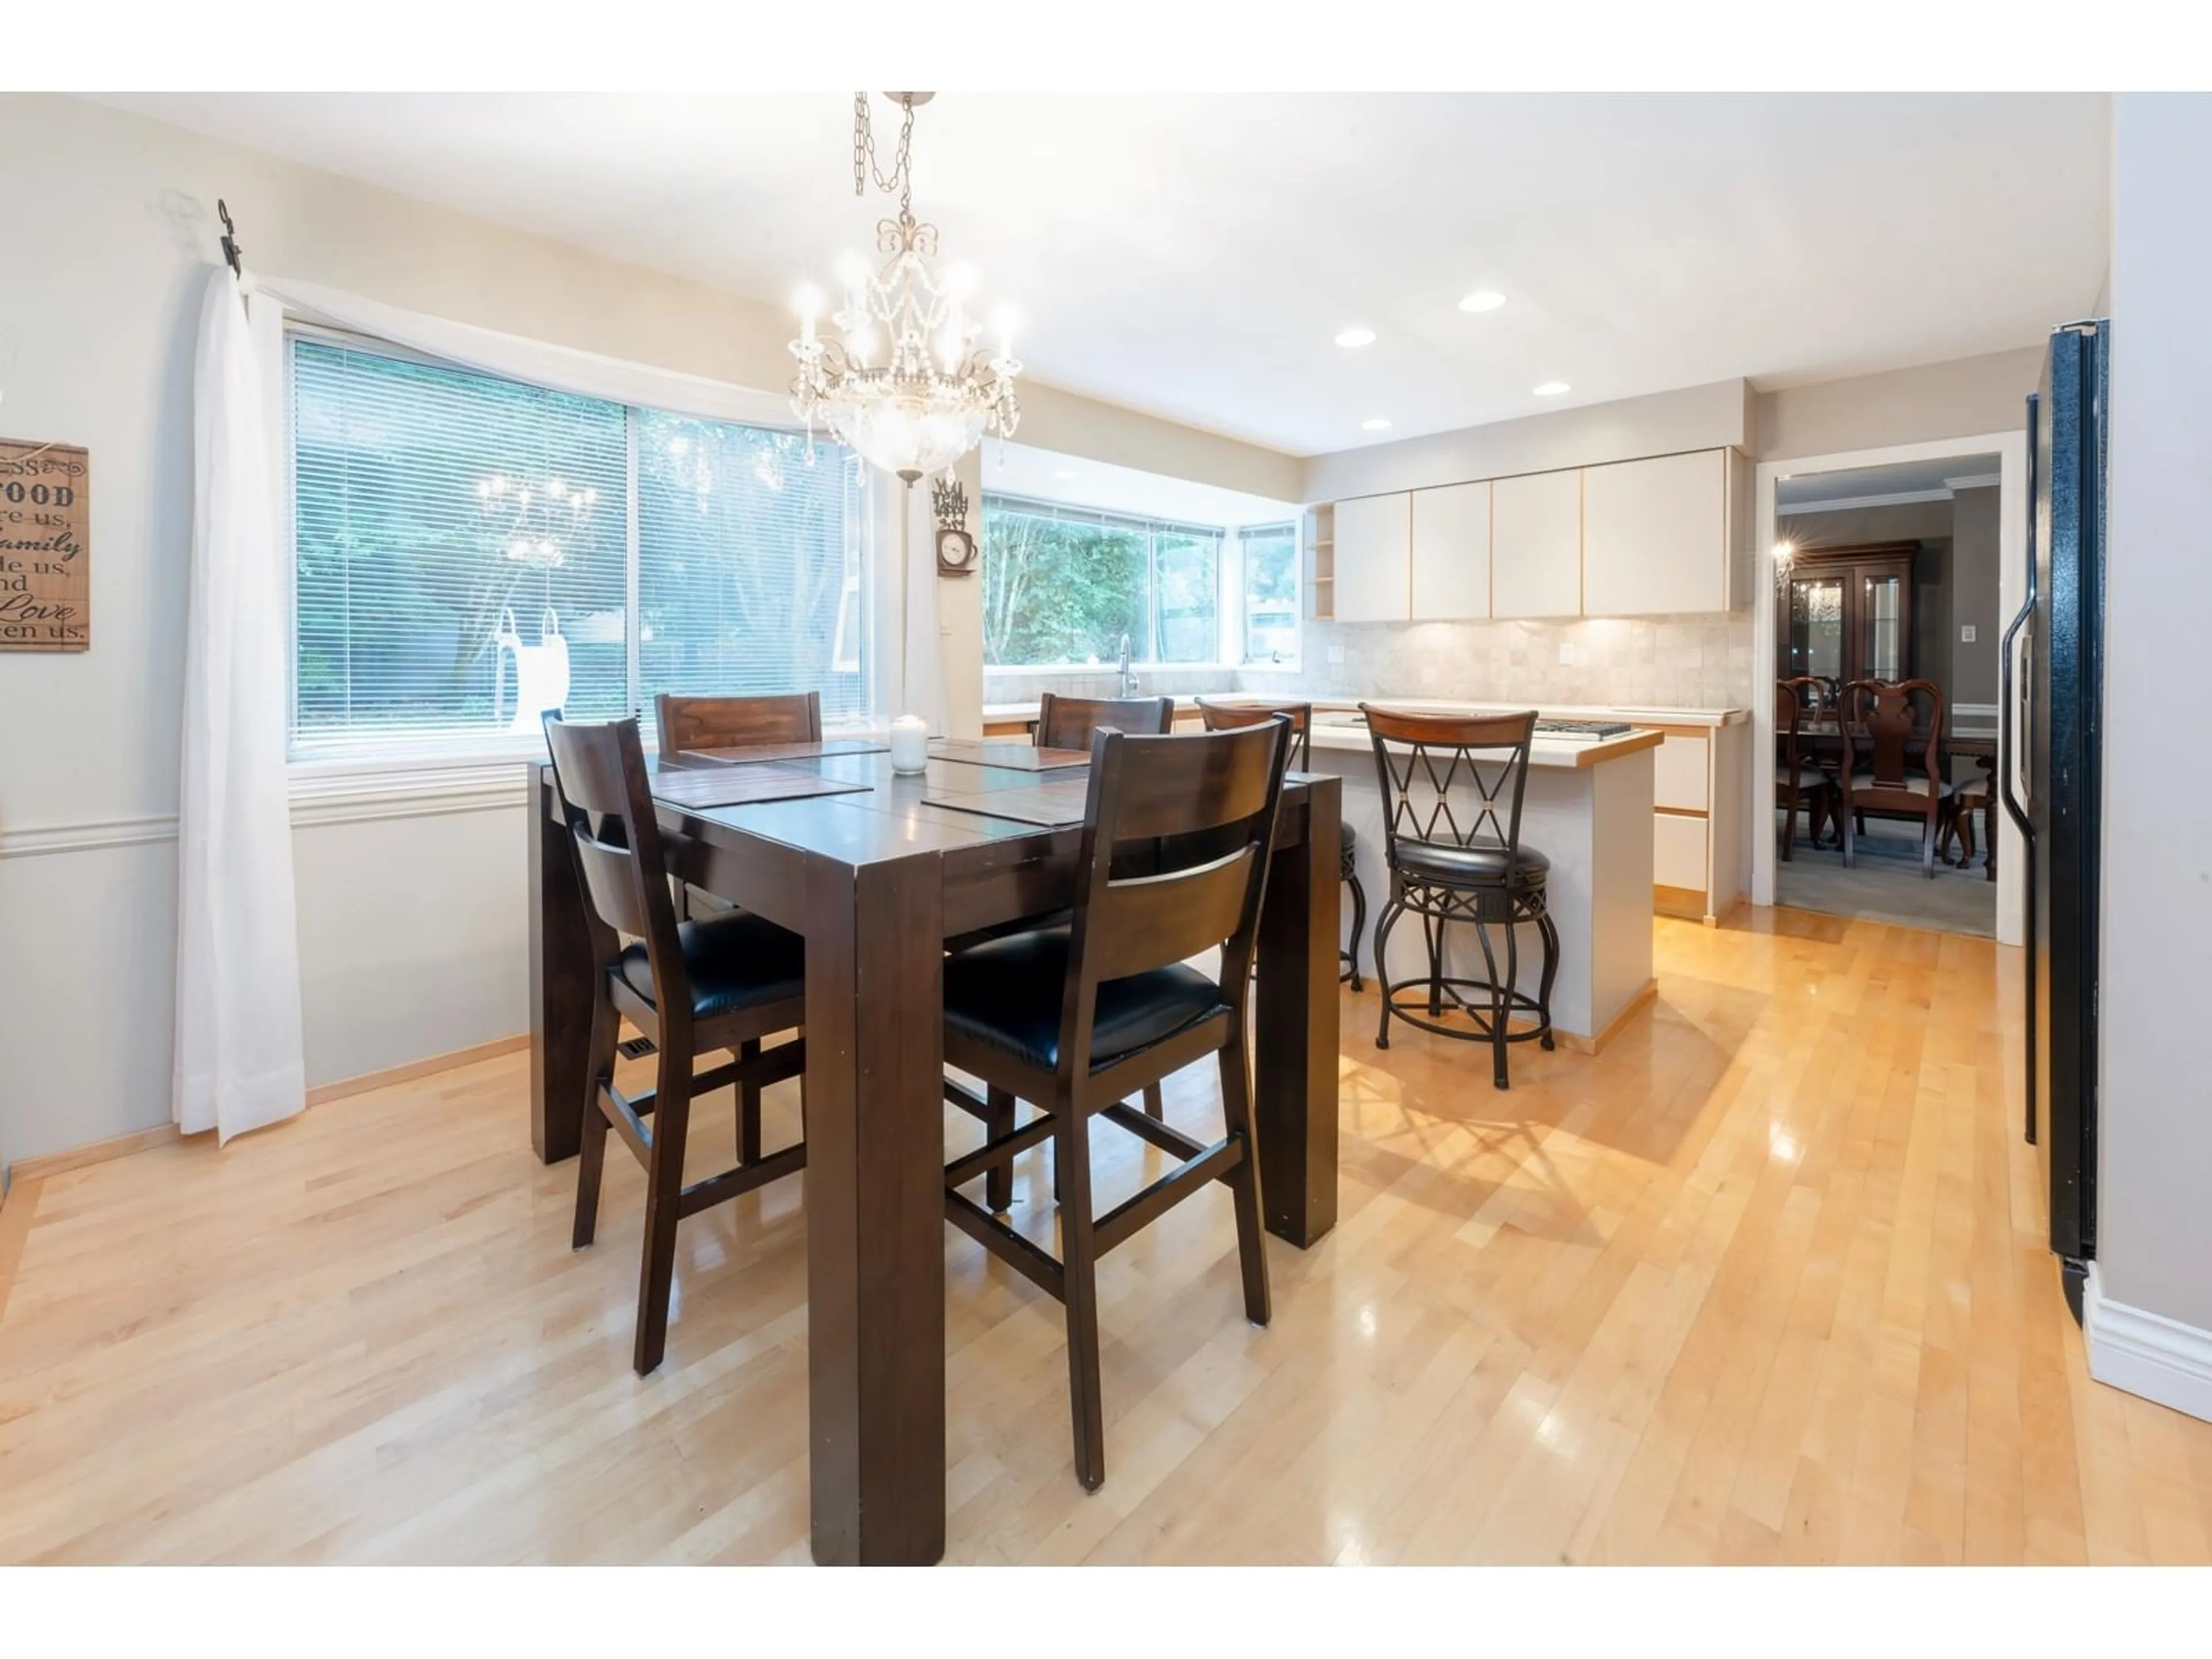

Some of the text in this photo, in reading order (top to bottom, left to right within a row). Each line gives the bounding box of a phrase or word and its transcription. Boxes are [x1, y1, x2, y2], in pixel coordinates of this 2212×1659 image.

[0, 459, 39, 477] SS
[0, 481, 74, 507] OOD
[33, 513, 71, 528] us,
[0, 525, 83, 562] amily
[33, 562, 71, 578] us,
[0, 593, 77, 623] Love
[0, 626, 85, 639] en us.
